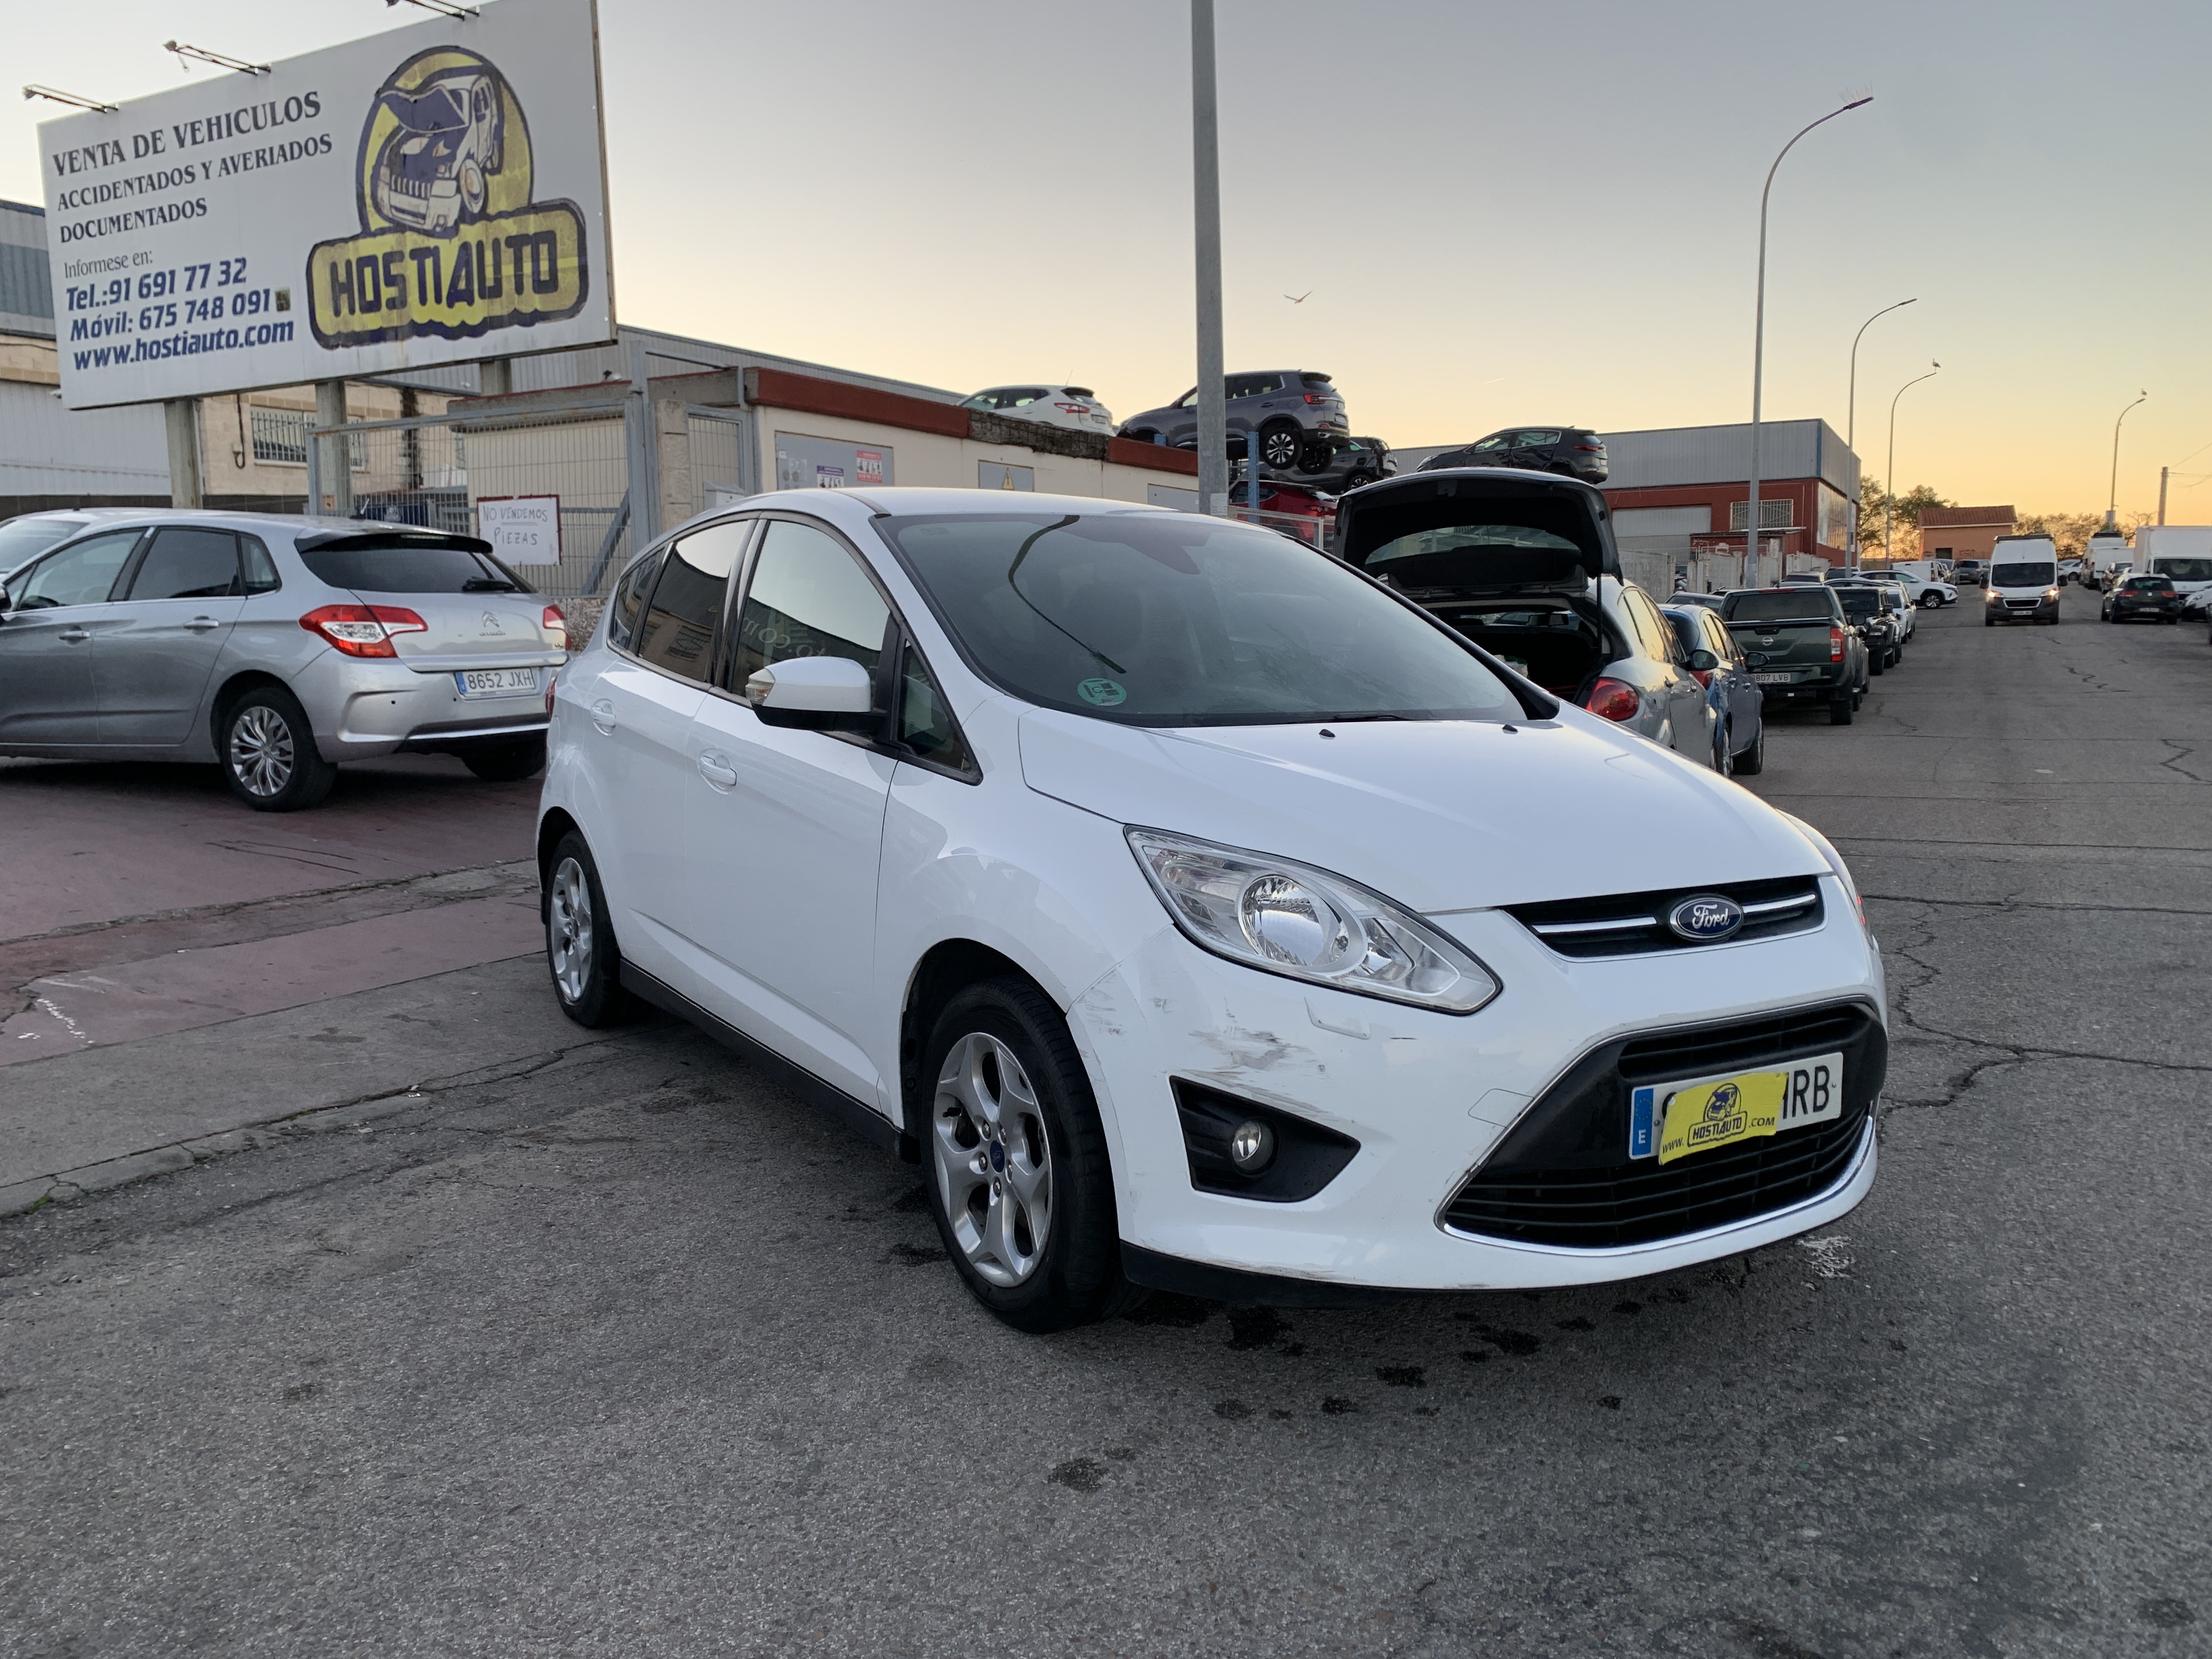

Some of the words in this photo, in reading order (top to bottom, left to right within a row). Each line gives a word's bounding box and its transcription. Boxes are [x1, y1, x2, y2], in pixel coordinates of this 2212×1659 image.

[53, 139, 126, 176] VENTA
[133, 129, 166, 159] DE
[173, 91, 321, 149] VEHICULOS
[58, 165, 196, 211] ACCIDENTADOS
[201, 160, 213, 179] Y
[218, 133, 332, 177] AVERIADOS
[60, 198, 207, 243] DOCUMENTADOS
[64, 253, 129, 278] Informese
[133, 250, 153, 265] en:
[66, 278, 131, 311] Tel.:91
[138, 269, 176, 297] 691
[184, 263, 211, 292] 77
[218, 257, 247, 285] 32
[330, 230, 558, 318] HOSTIAUTO
[70, 312, 133, 341] Móvil:
[139, 302, 177, 331] 675
[185, 296, 223, 324] 748
[232, 289, 270, 316] 091
[74, 321, 294, 371] www.hostiauto.com
[483, 505, 497, 522] NO
[500, 506, 548, 522] VENDEMOS
[467, 673, 504, 689] 8652
[509, 671, 532, 686] JXH
[1692, 904, 1730, 929] Ford
[1638, 1130, 1646, 1144] E
[1692, 1118, 1742, 1140] HOSTIAUTO
[1748, 1117, 1775, 1128] .COM
